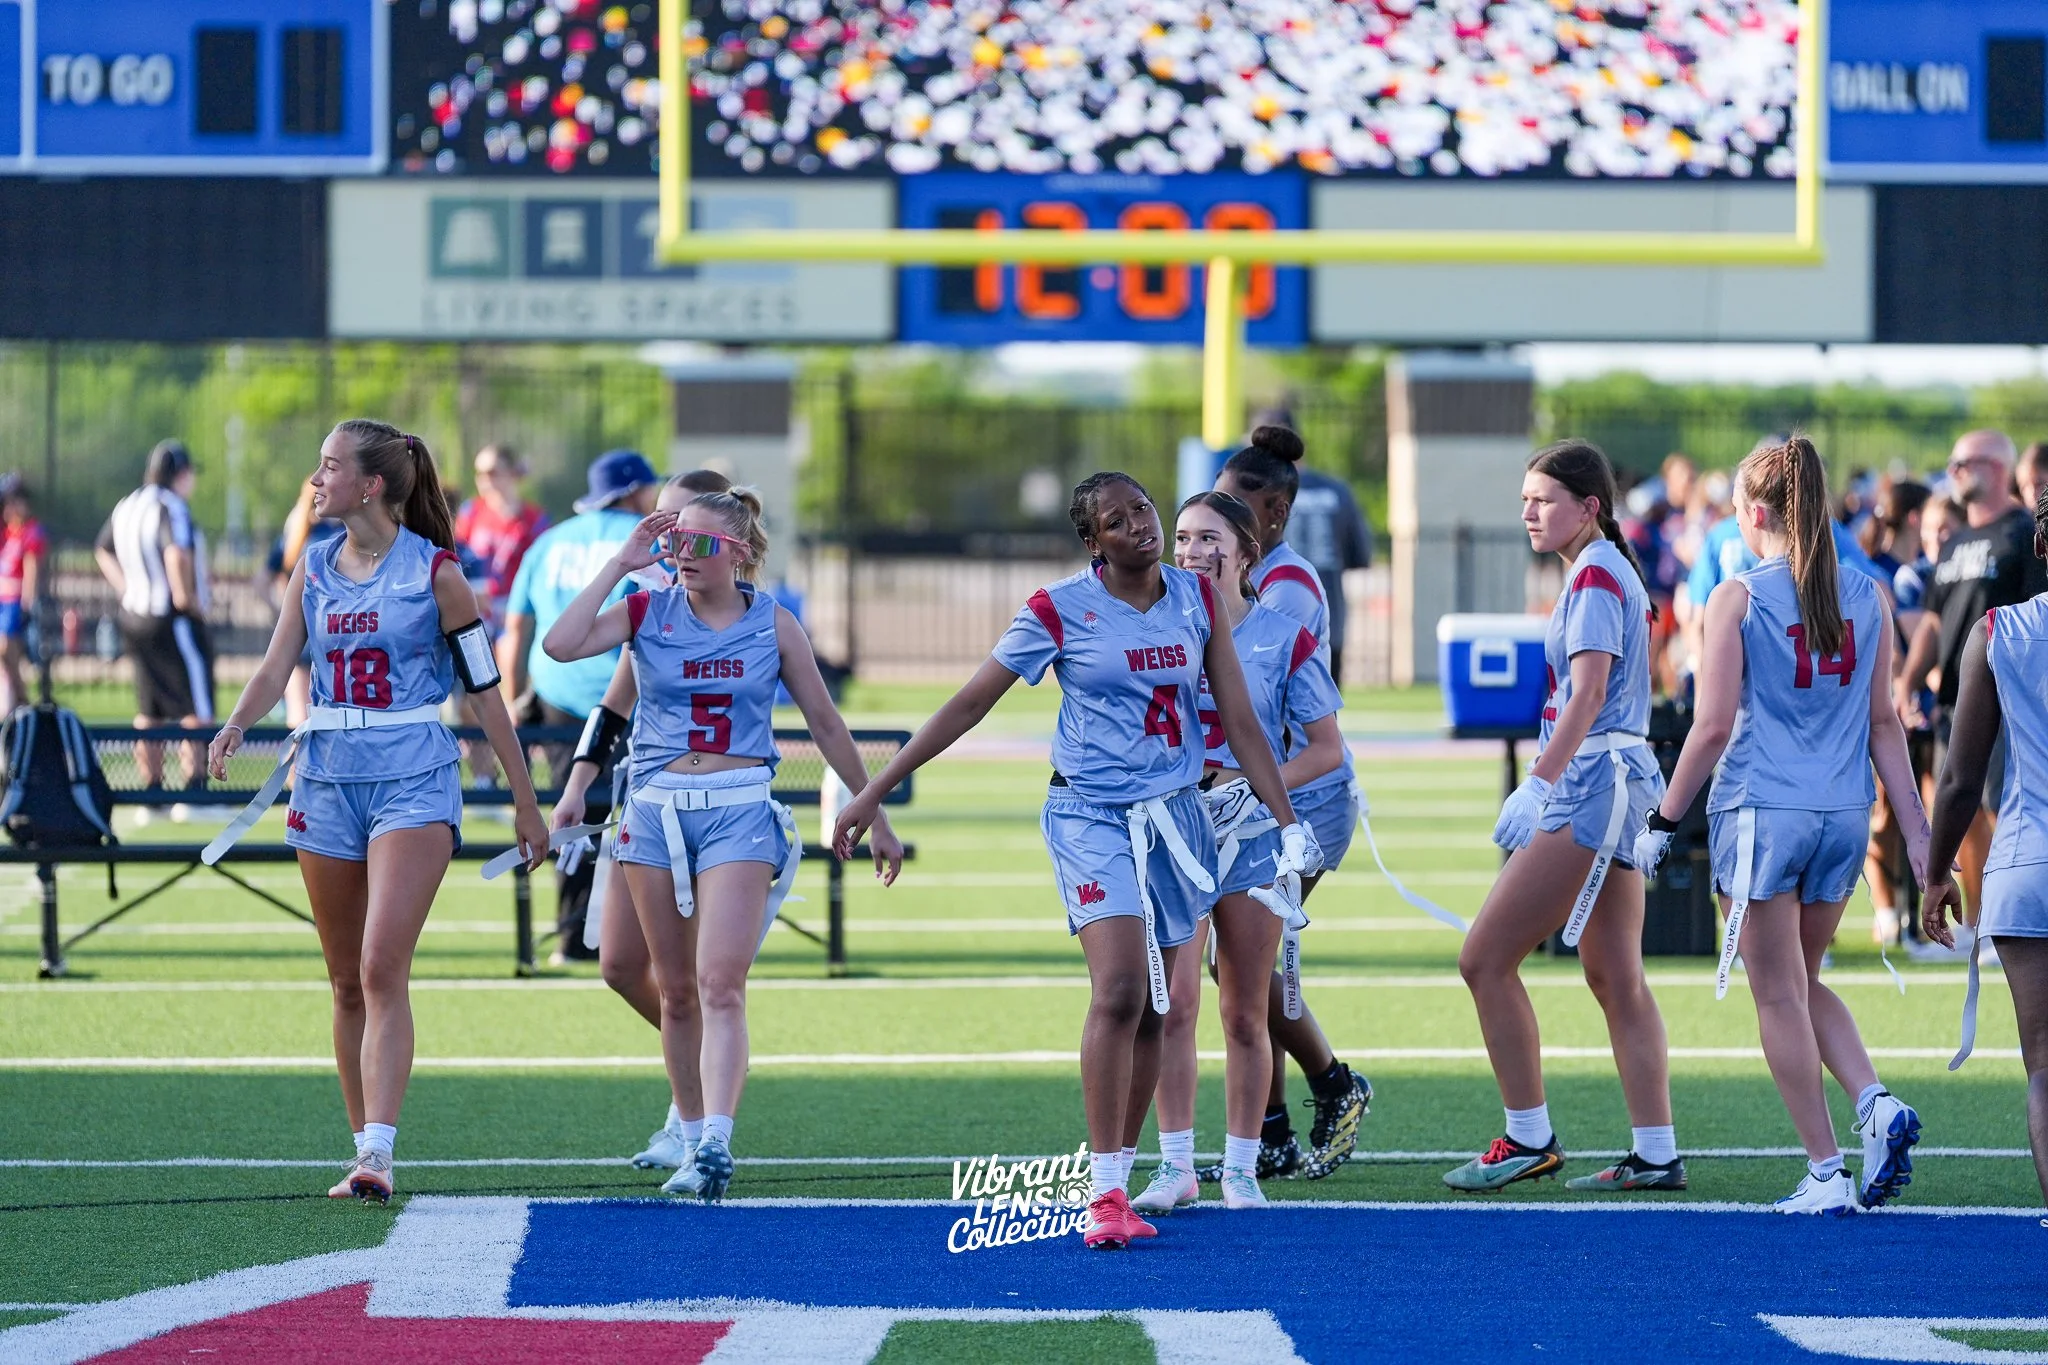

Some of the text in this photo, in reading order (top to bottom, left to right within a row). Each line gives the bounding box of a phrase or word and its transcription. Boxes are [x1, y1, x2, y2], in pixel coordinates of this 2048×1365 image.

[43, 53, 173, 106] TO GO
[1829, 61, 1969, 114] BALL ON
[327, 611, 379, 634] WEISS
[325, 647, 393, 709] 18
[683, 659, 744, 679] WEISS
[1123, 643, 1188, 672] WEISS
[1786, 618, 1857, 688] 14
[688, 693, 733, 754] 5
[1144, 683, 1182, 748] 4
